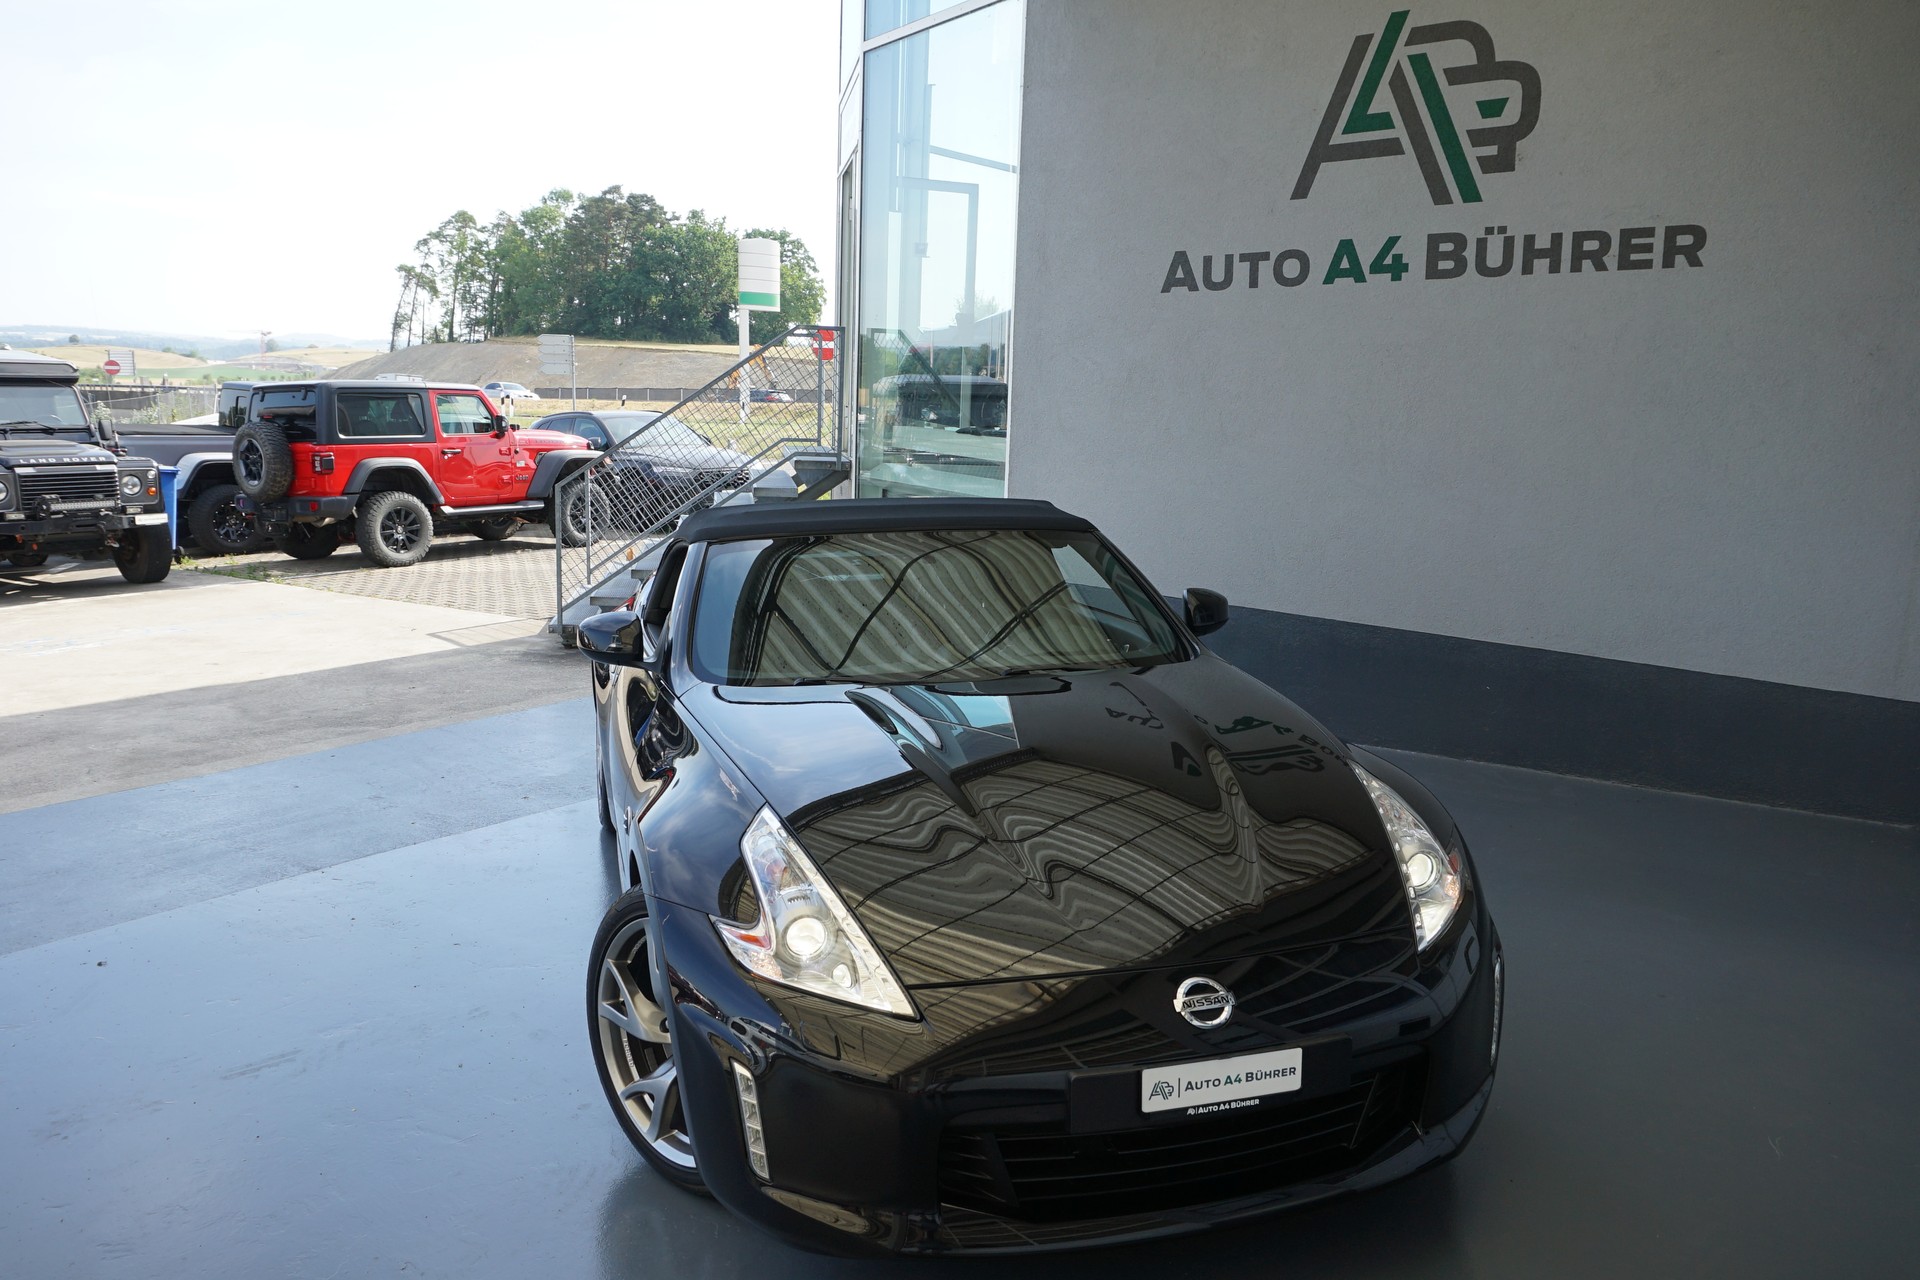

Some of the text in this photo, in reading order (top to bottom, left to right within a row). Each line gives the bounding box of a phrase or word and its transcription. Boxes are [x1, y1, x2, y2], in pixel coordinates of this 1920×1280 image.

[1160, 223, 1708, 294] AUTO A4 BÜHRER
[1182, 995, 1230, 1009] NISSAN
[1185, 1079, 1221, 1091] AUTO
[1223, 1073, 1243, 1087] A4
[1246, 1067, 1297, 1082] BÜHRER
[1197, 1105, 1218, 1114] AUTO
[1219, 1102, 1230, 1111] A4
[1231, 1099, 1259, 1108] BÜHRER
